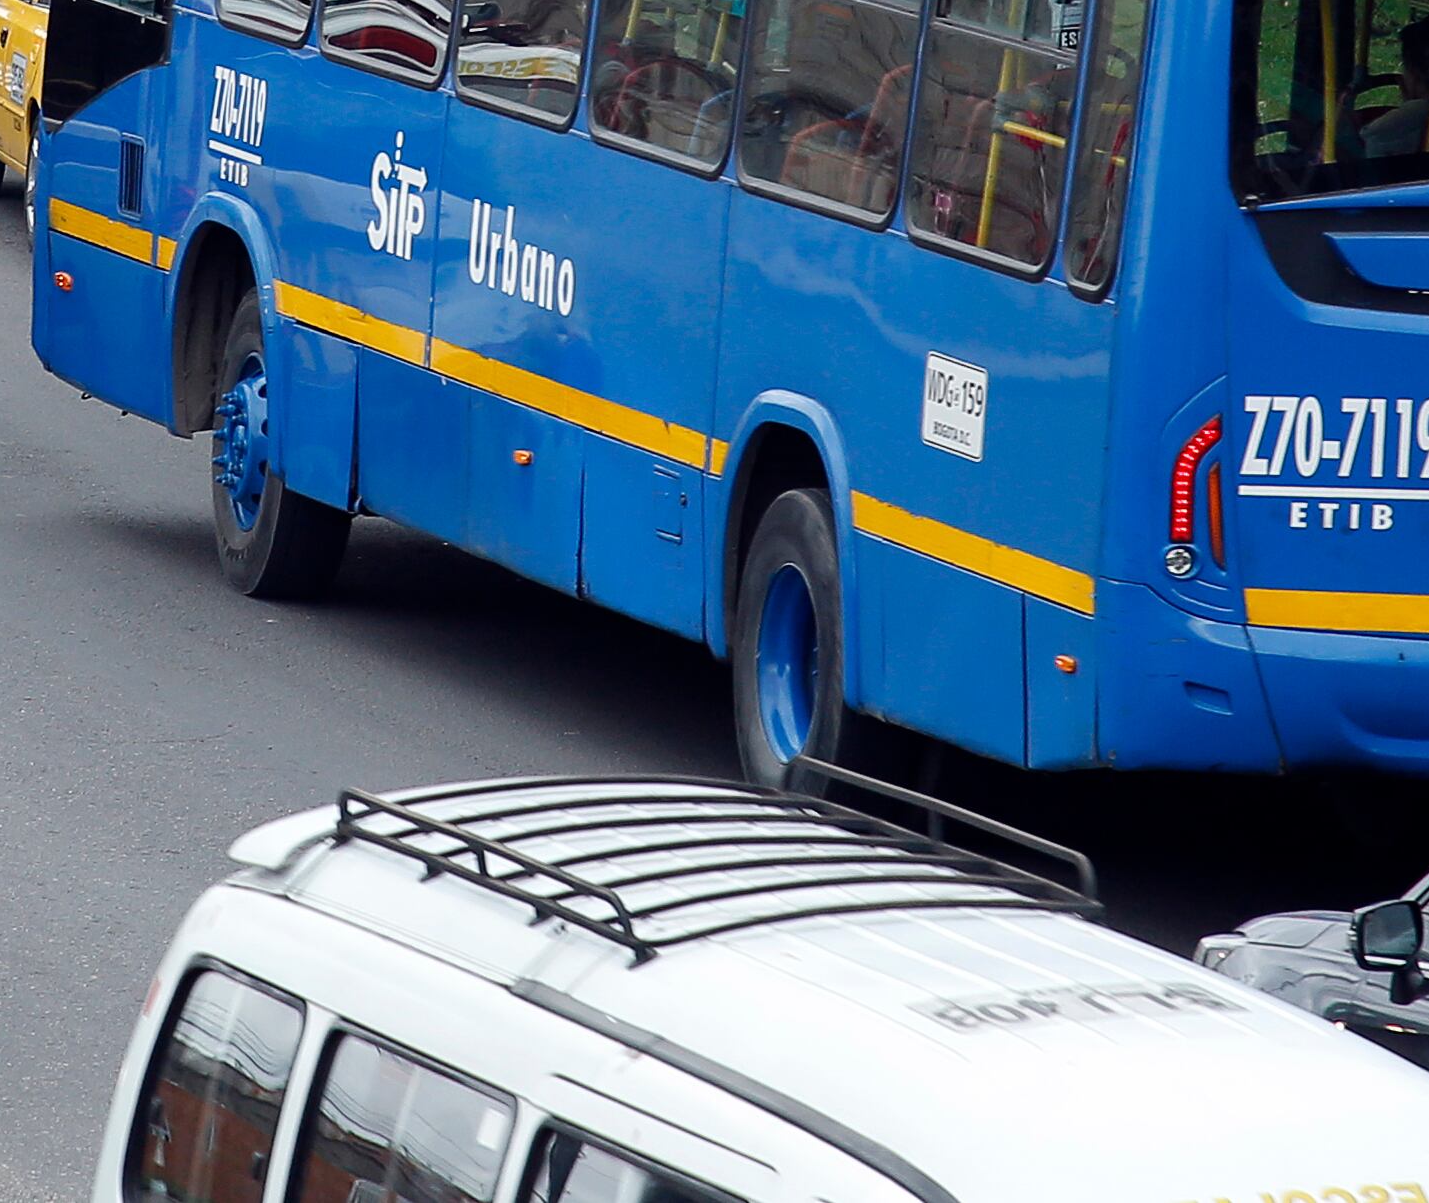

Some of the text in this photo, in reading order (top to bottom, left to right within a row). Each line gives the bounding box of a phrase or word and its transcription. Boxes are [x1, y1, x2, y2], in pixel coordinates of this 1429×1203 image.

[210, 65, 267, 147] Z70-7119
[220, 157, 249, 188] ETIB
[469, 198, 575, 317] Urbano
[1289, 502, 1393, 530] ETIB
